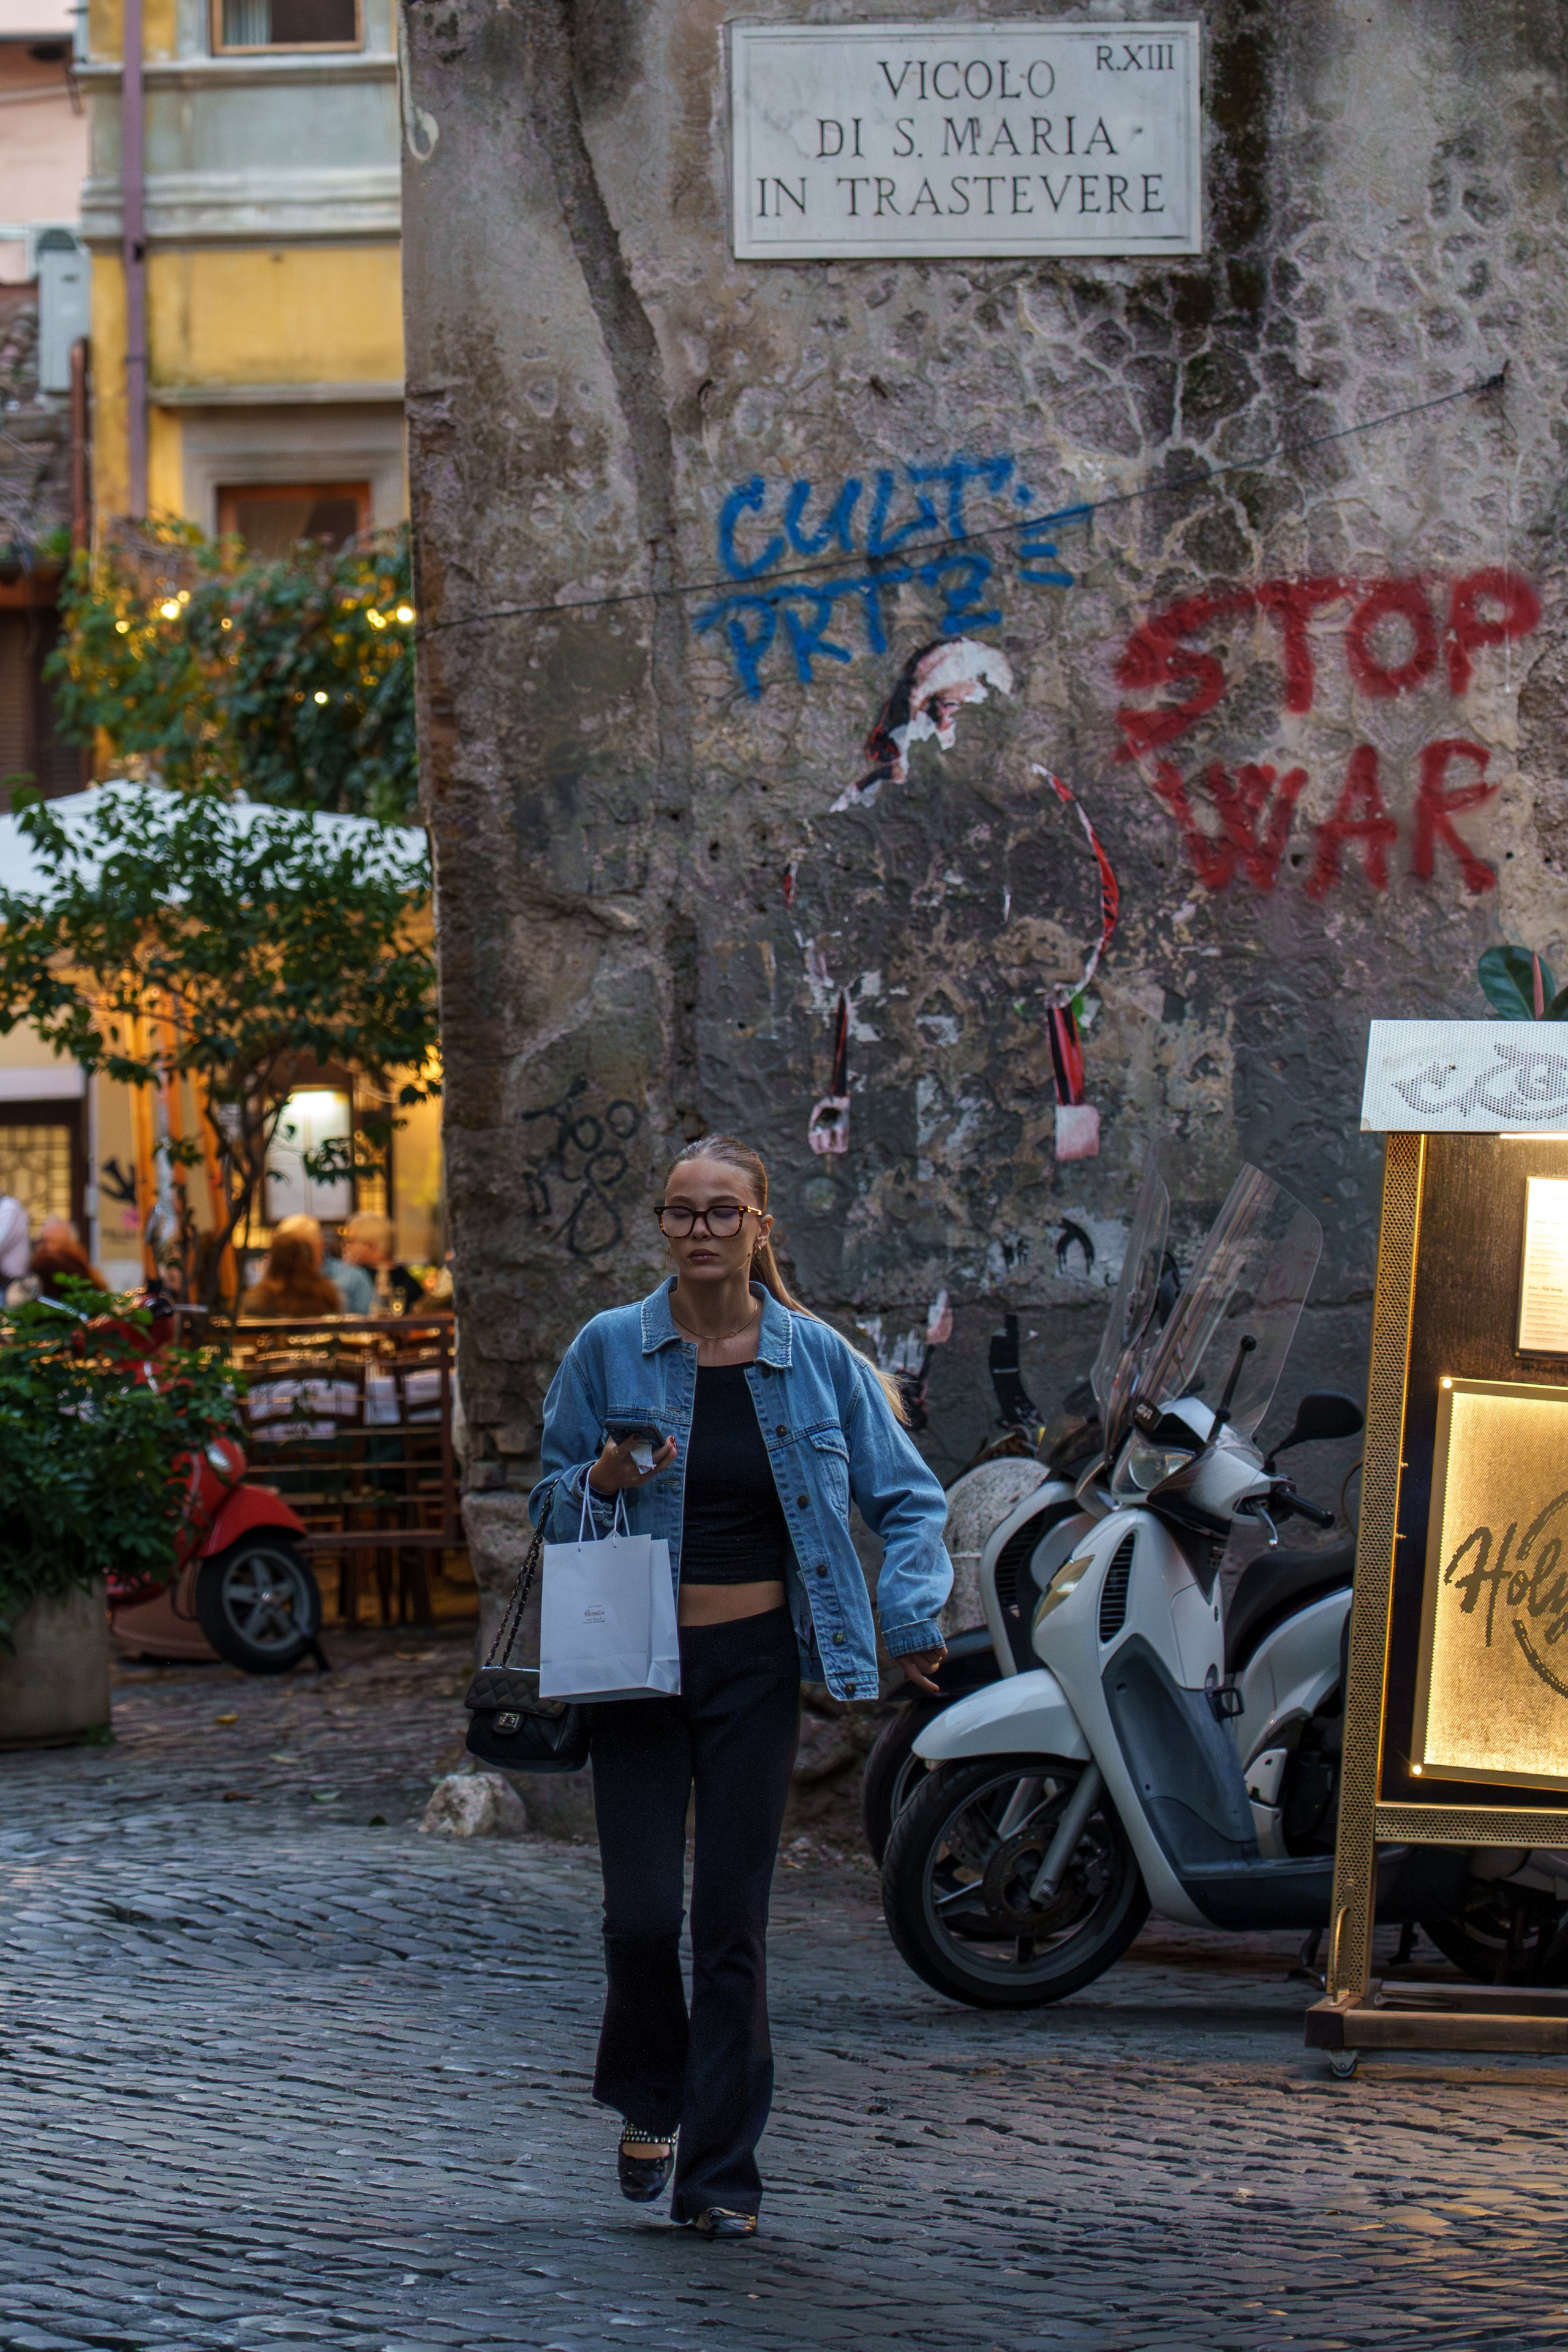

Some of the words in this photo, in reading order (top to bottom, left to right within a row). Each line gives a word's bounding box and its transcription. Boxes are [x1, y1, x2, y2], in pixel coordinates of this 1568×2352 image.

[877, 59, 1056, 100] VICOLO
[1096, 44, 1175, 72] R.XIII
[815, 118, 864, 159] DI
[893, 118, 924, 159] S.
[941, 116, 1119, 157] MARIA
[756, 177, 809, 217] IN
[836, 174, 1166, 217] TRASTEVERE
[1110, 566, 1541, 763] STOP
[1152, 739, 1501, 903] WAR
